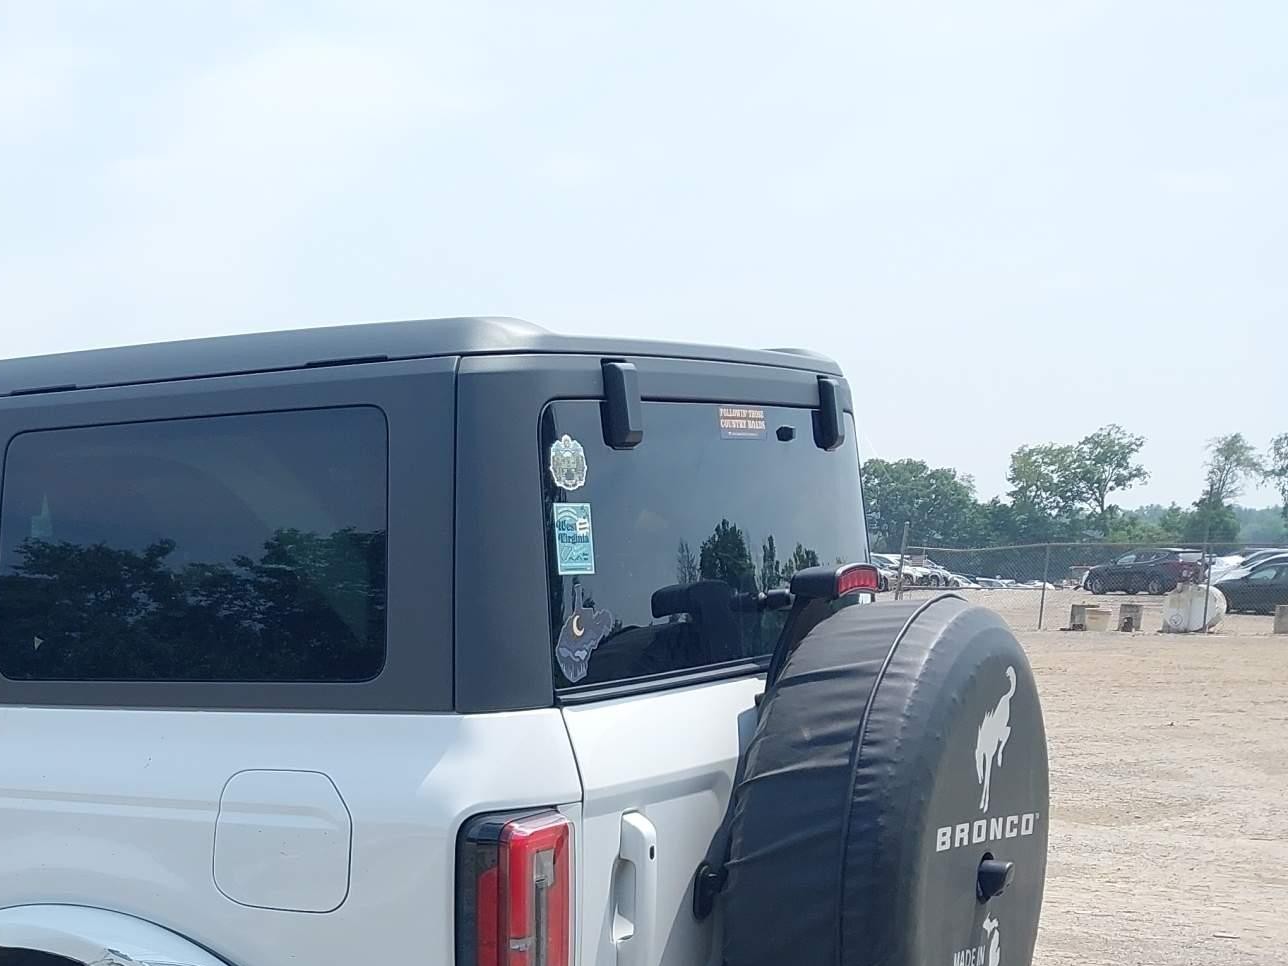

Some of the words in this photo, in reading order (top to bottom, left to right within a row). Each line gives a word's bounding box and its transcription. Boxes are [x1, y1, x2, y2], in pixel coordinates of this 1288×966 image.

[720, 419, 747, 429] COUNTRY
[558, 532, 590, 545] Virginia
[936, 813, 1035, 852] BRONCO
[976, 944, 986, 966] IN
